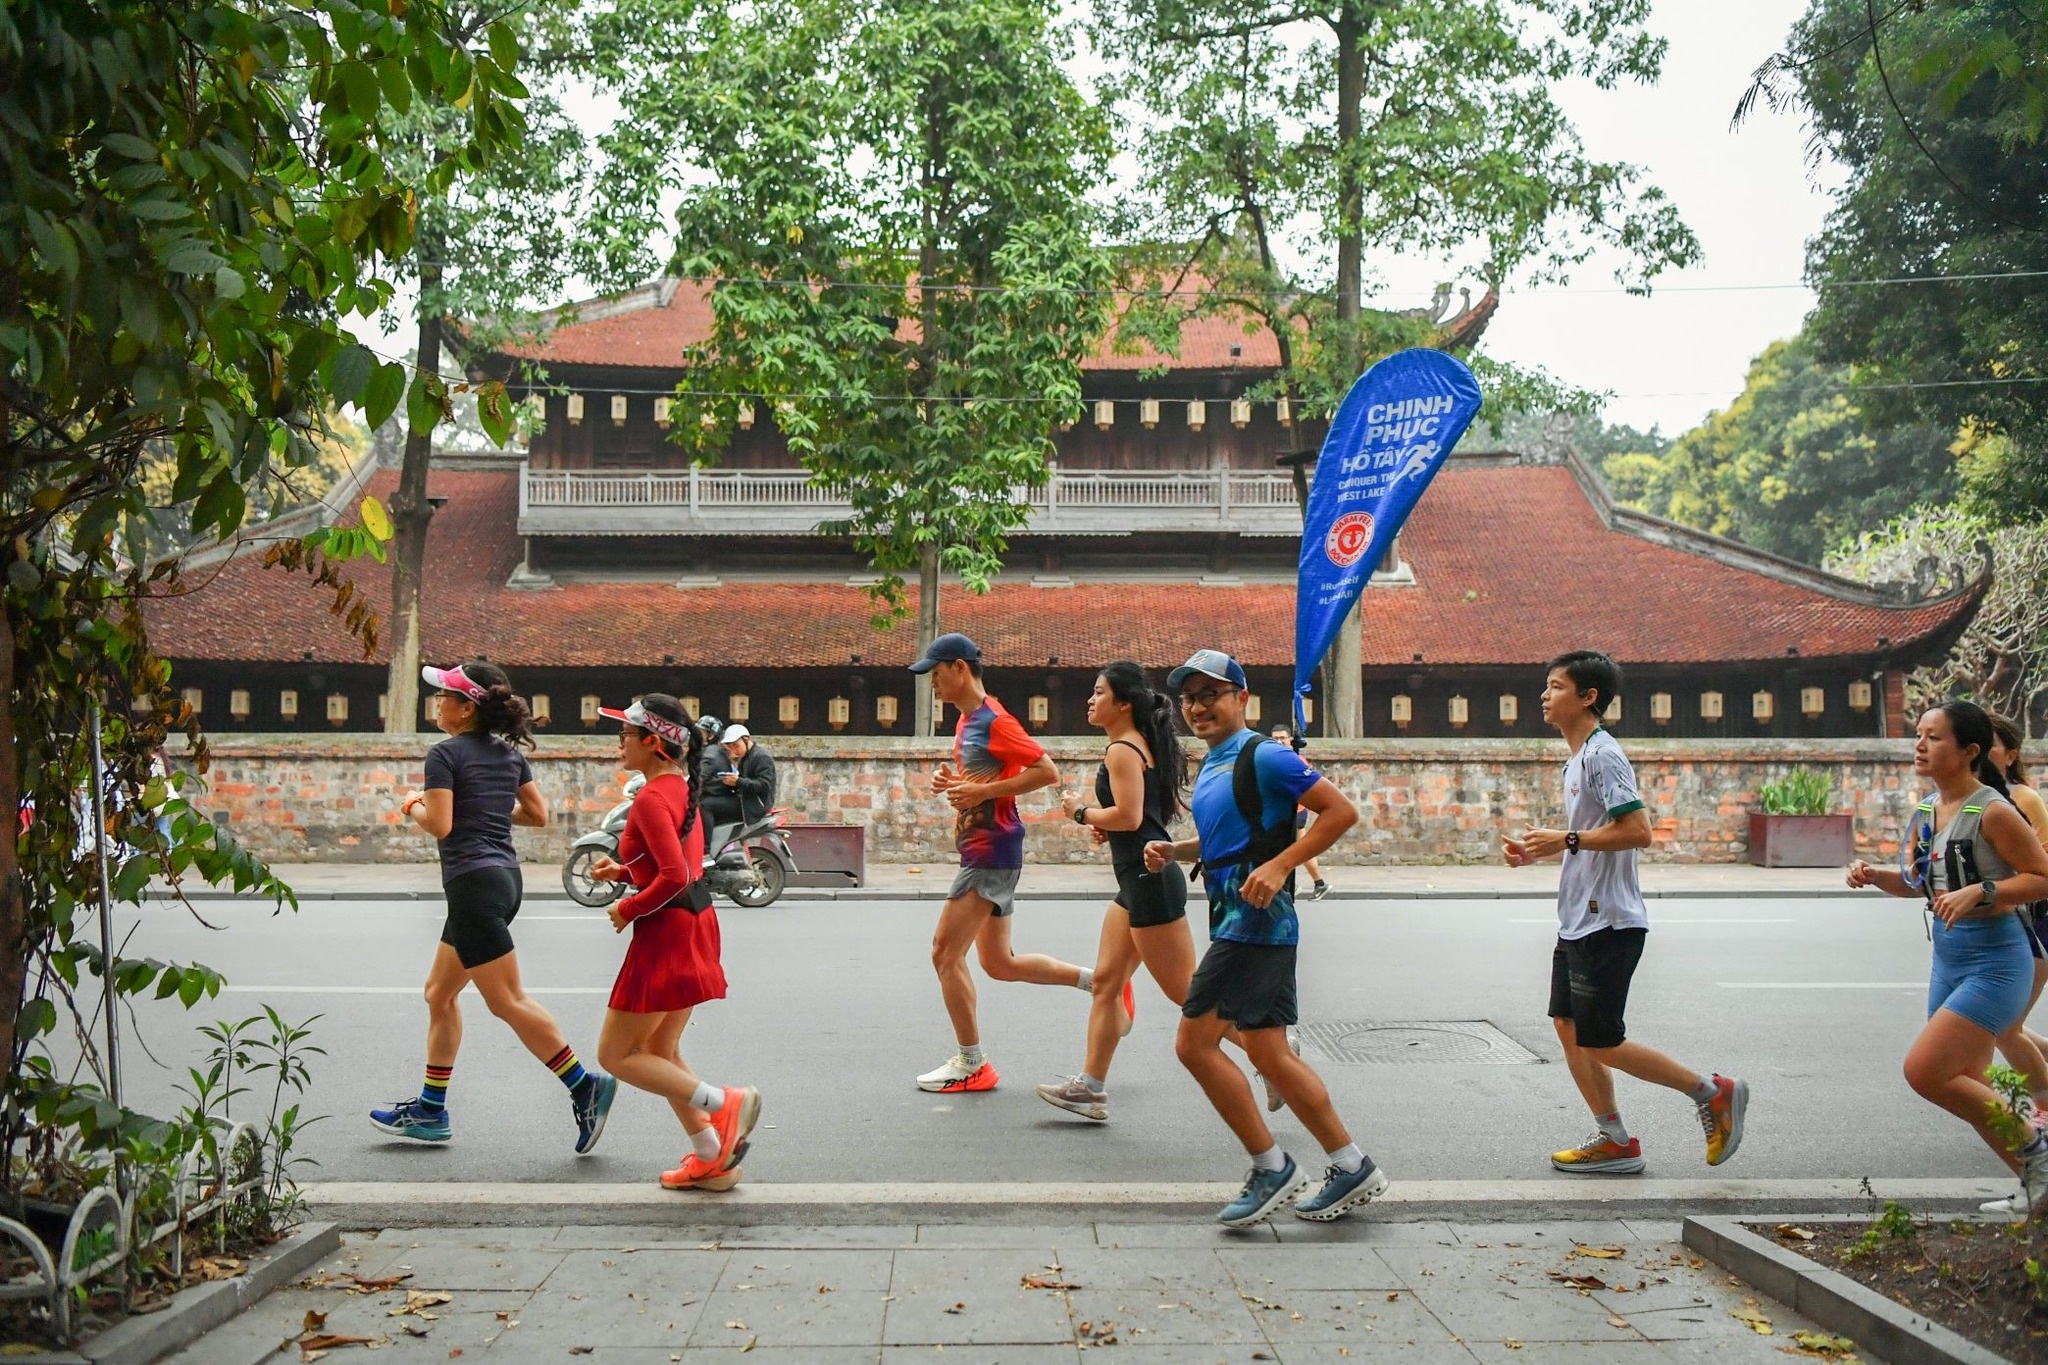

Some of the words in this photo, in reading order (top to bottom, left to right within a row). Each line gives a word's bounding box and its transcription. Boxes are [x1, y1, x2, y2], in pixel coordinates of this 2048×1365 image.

[1367, 394, 1454, 425] CHINH
[1365, 416, 1441, 446] PHỤC
[1340, 447, 1371, 474] HỒ
[1372, 445, 1407, 470] TÂY
[1363, 486, 1386, 500] LAKE
[1331, 515, 1358, 535] WARM
